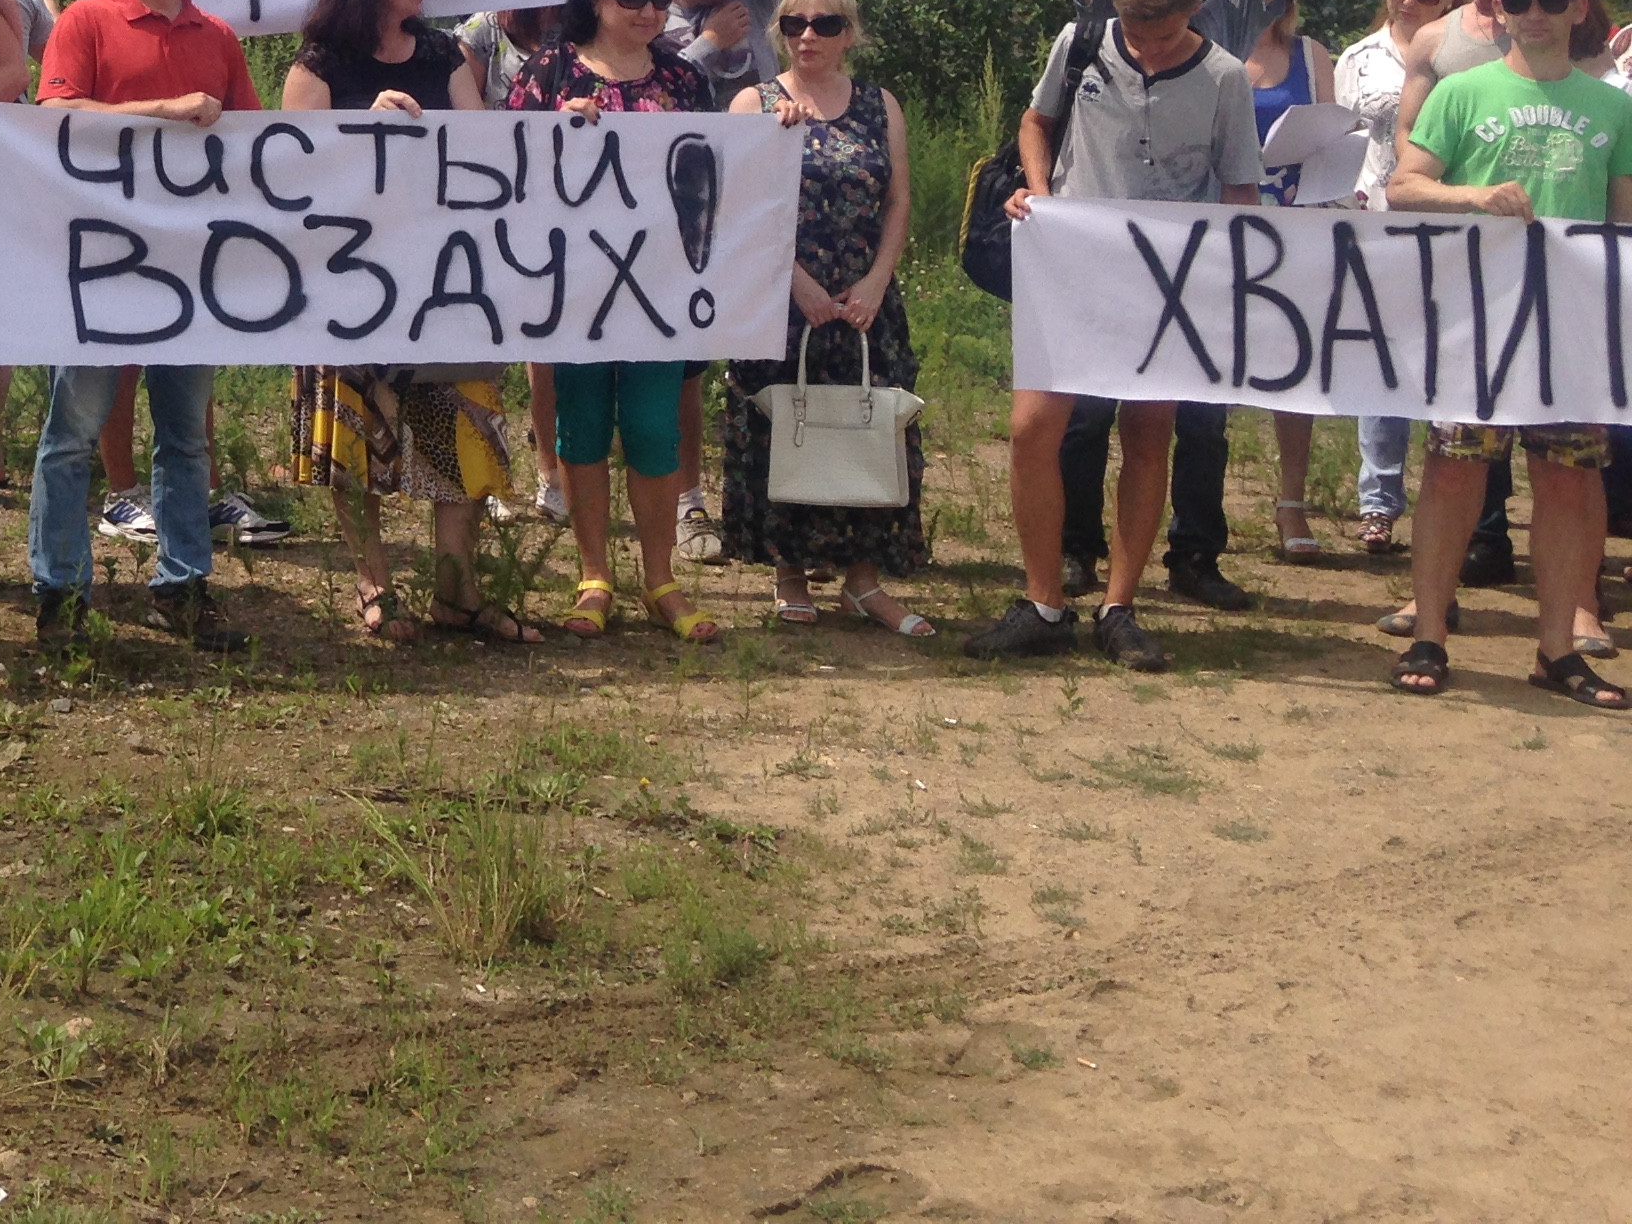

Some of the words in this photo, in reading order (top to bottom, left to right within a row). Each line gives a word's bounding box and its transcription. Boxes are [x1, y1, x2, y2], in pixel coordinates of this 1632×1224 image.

[1474, 116, 1506, 143] CC
[1508, 104, 1591, 135] DOUBLE
[1127, 214, 1632, 421] ХВАТИТ
